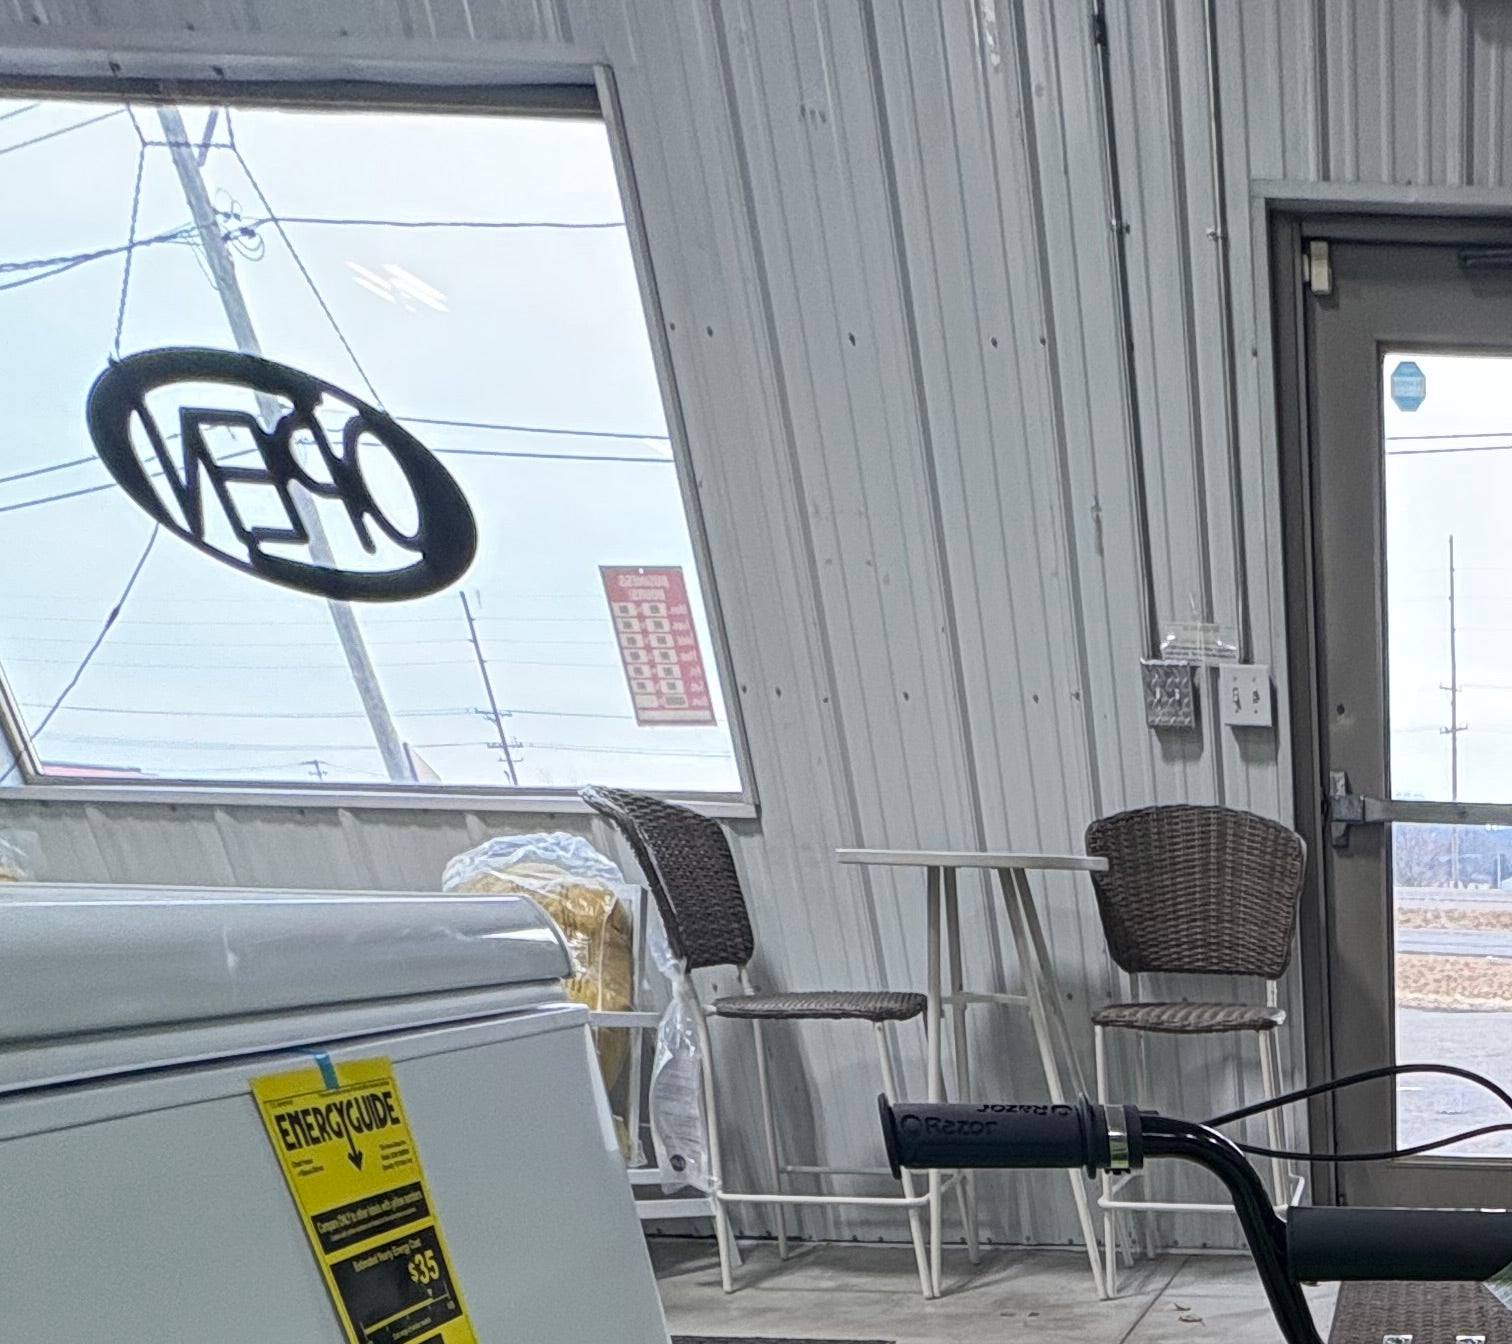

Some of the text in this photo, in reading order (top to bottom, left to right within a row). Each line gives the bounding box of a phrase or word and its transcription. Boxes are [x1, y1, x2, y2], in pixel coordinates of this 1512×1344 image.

[275, 1091, 401, 1151] ENERGYGUIDE
[925, 1116, 998, 1136] Razor
[407, 1249, 440, 1285] $35
